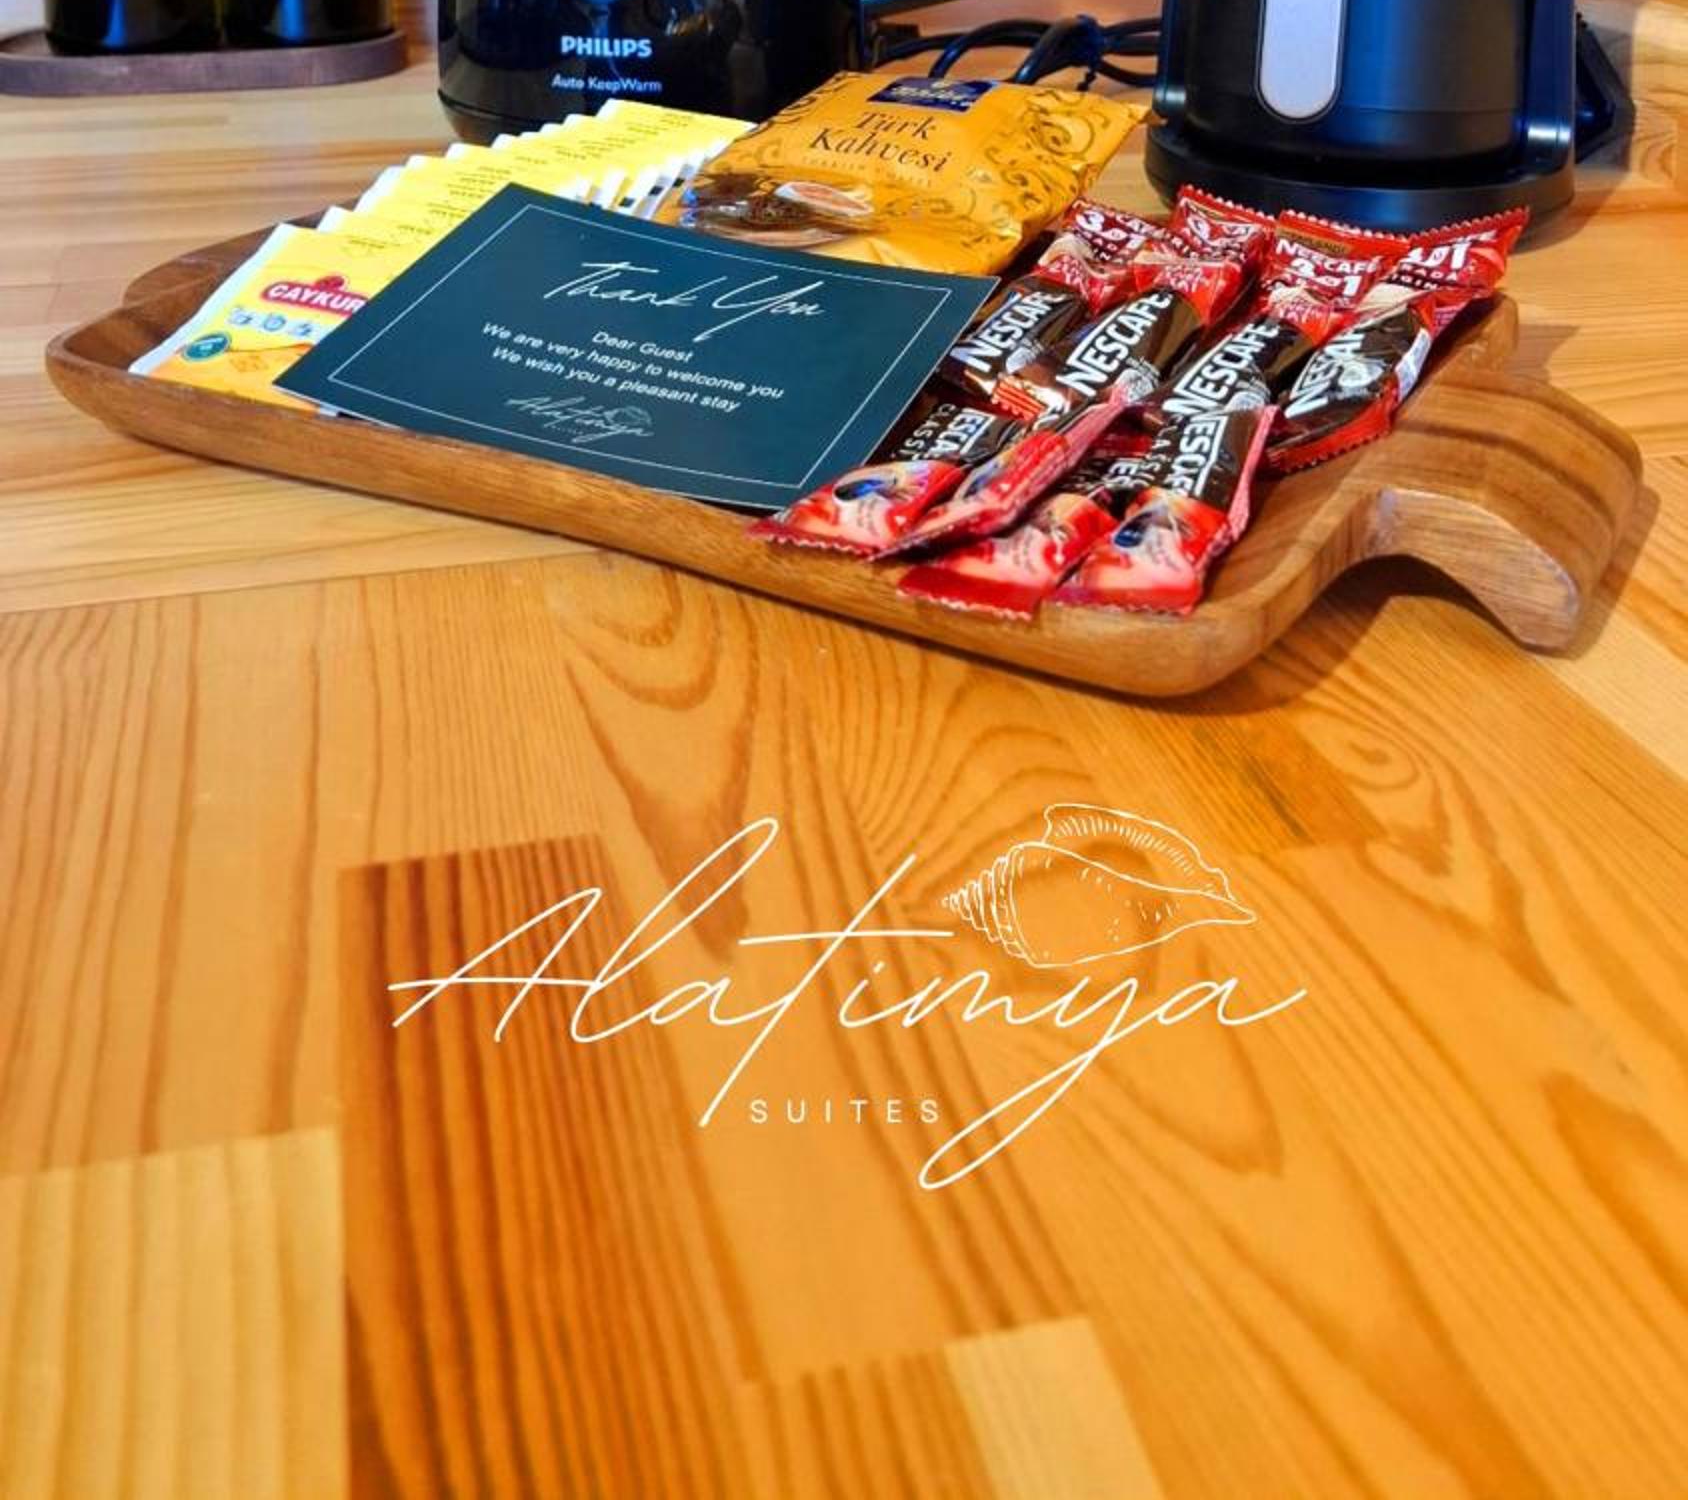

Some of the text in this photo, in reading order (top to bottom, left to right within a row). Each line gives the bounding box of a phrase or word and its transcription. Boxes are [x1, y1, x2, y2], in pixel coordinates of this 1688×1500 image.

[560, 35, 653, 58] PHILIPS
[552, 73, 662, 94] Auto KeepWarm
[855, 110, 936, 141] Türk
[809, 127, 952, 172] Kahvesi
[543, 261, 826, 343] Thank You
[483, 321, 785, 400] We are very happy to welcome you
[592, 331, 694, 363] Dear Guest
[492, 346, 742, 413] We wish you a pleasant stay
